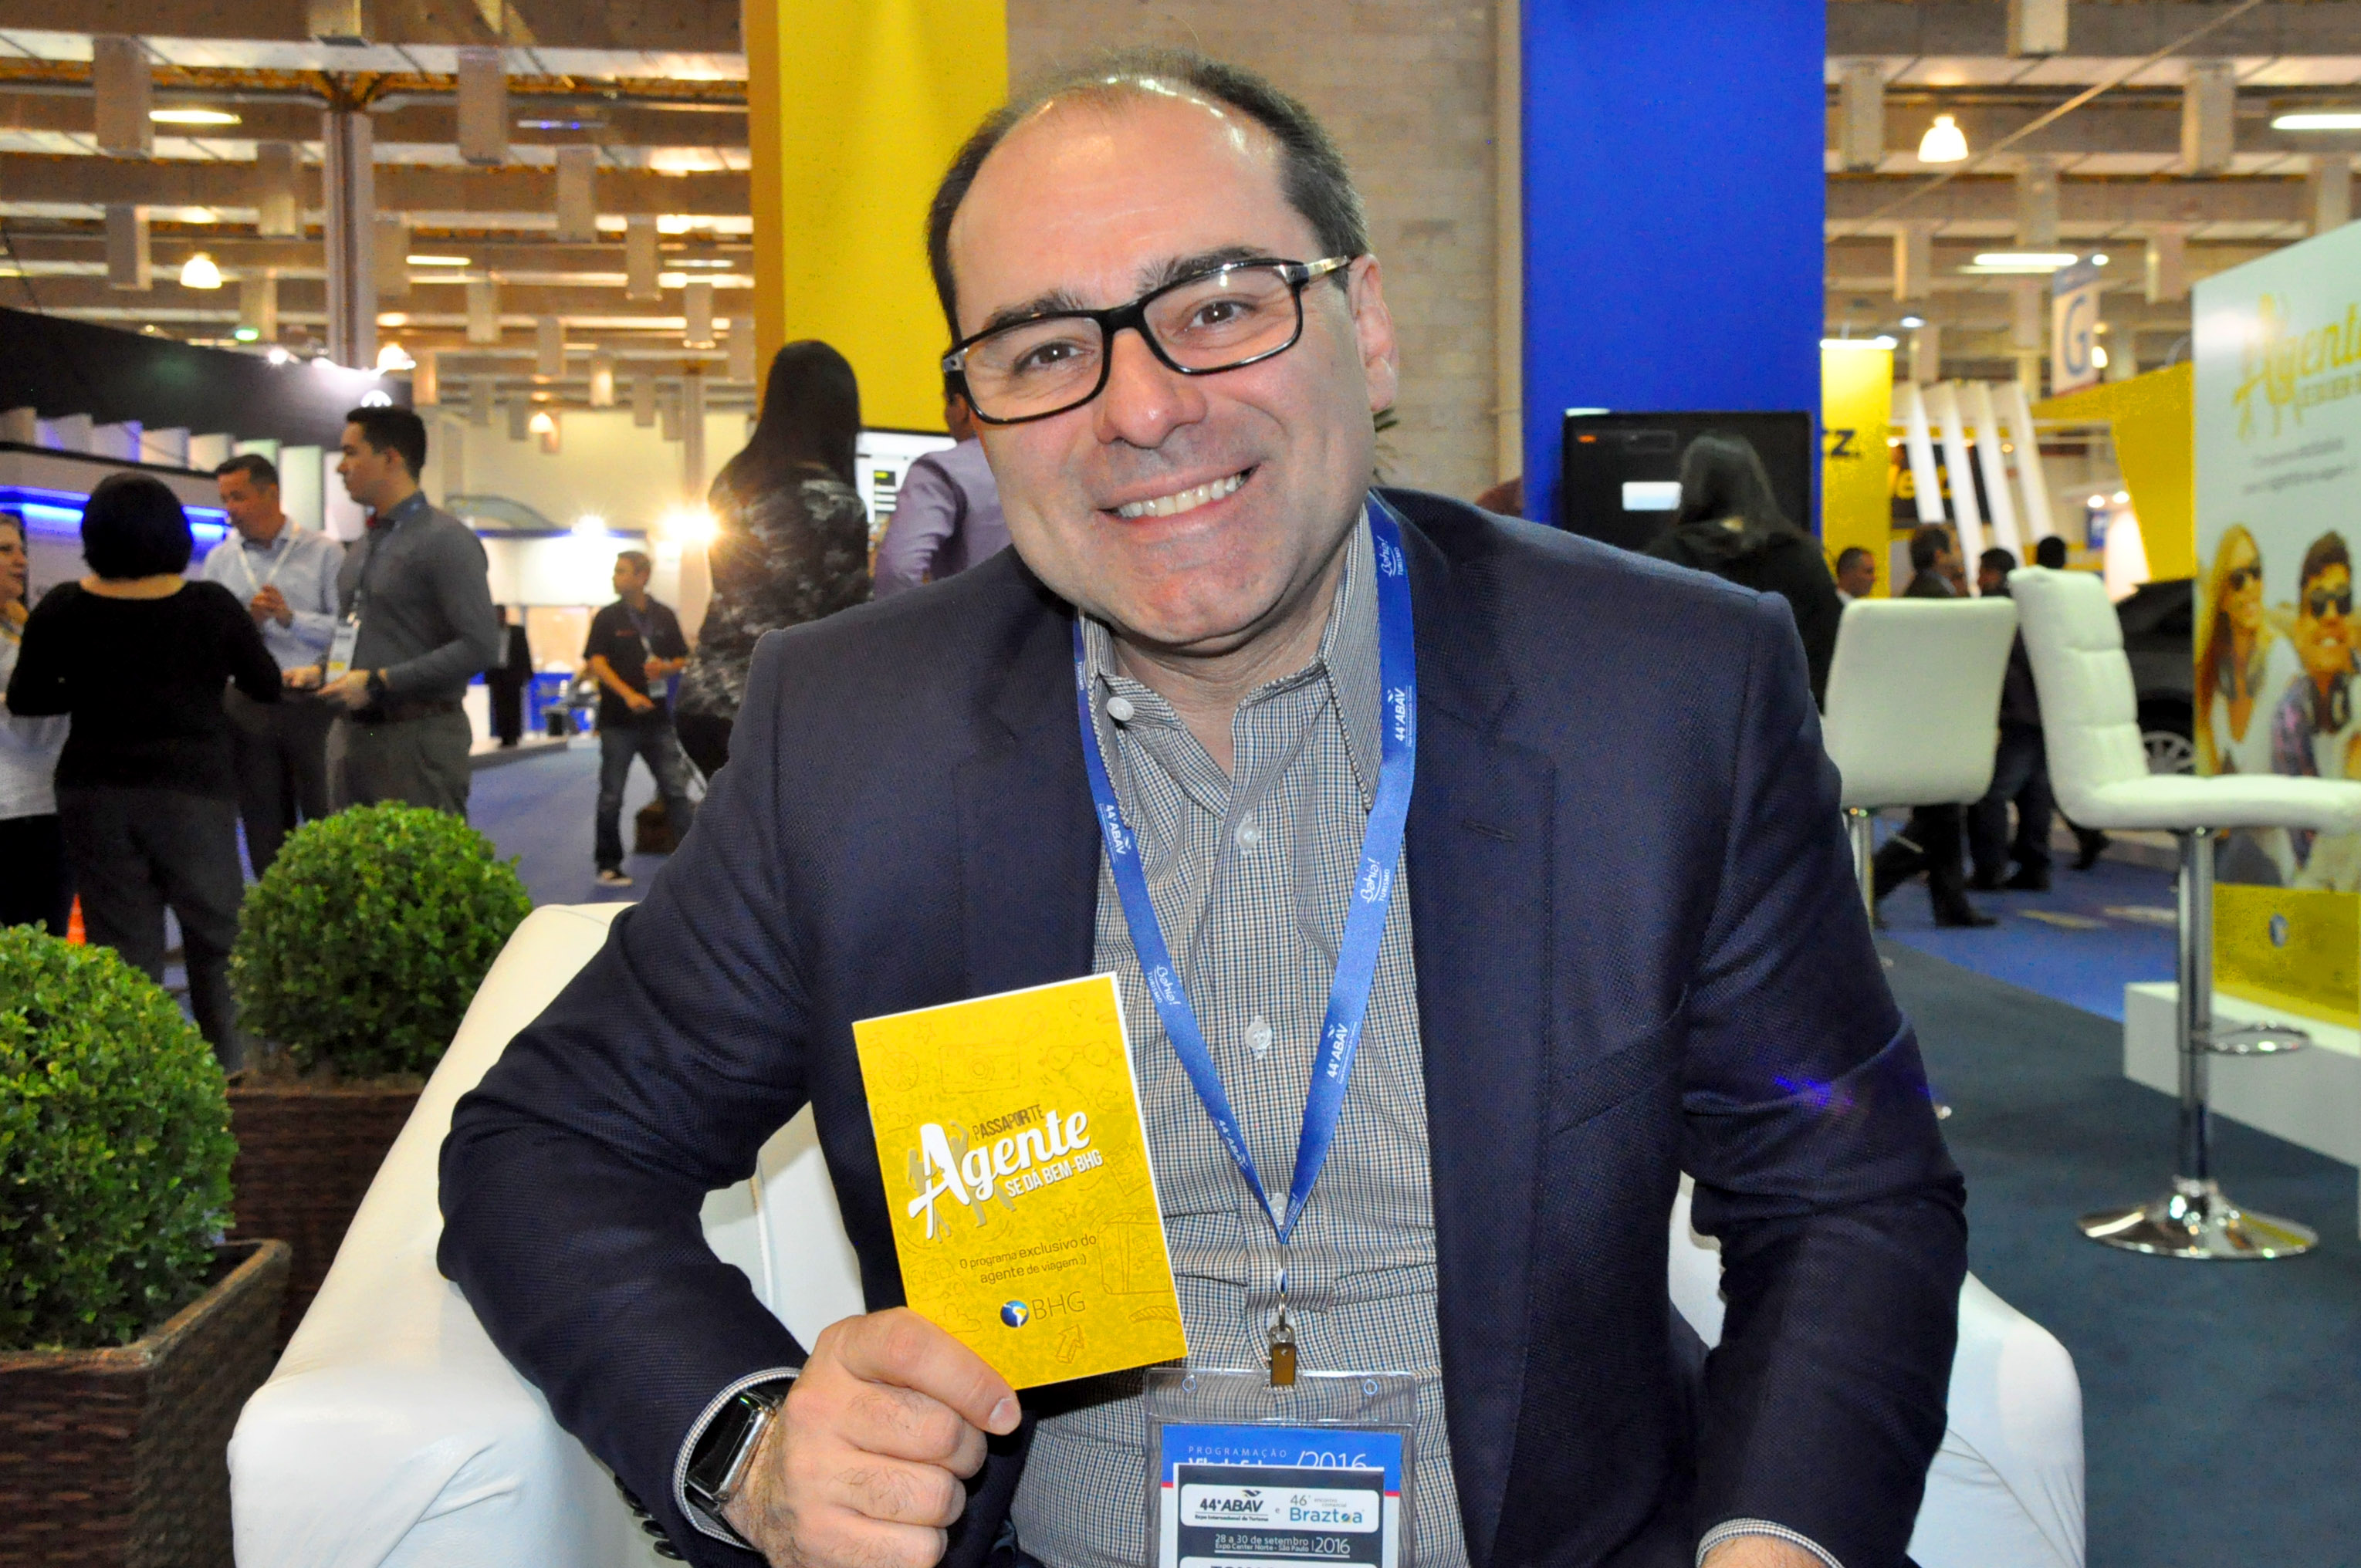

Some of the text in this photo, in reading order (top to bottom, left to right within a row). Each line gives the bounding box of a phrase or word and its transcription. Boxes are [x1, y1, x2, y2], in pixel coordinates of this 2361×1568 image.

[2064, 293, 2087, 377] G
[2231, 292, 2361, 441] Agent
[1378, 869, 1390, 901] TURISMO
[1147, 972, 1162, 1003] TURISMO
[972, 1103, 1044, 1141] PASSAPORTE
[908, 1110, 1091, 1239] Agente
[1005, 1176, 1026, 1198] SE
[1023, 1168, 1044, 1191] DÁ
[959, 1234, 1097, 1269] O programa exclusivo do
[980, 1266, 1025, 1285] agente
[1027, 1264, 1040, 1274] de
[1041, 1257, 1078, 1271] viagem
[1032, 1291, 1086, 1320] BHG
[1189, 1445, 1287, 1458] PROGRAMAÇÃO
[1215, 1533, 1226, 1543] 28
[1236, 1534, 1248, 1543] 30
[1250, 1536, 1262, 1544] de
[1264, 1536, 1309, 1546] setembro
[1314, 1536, 1350, 1554] 2016
